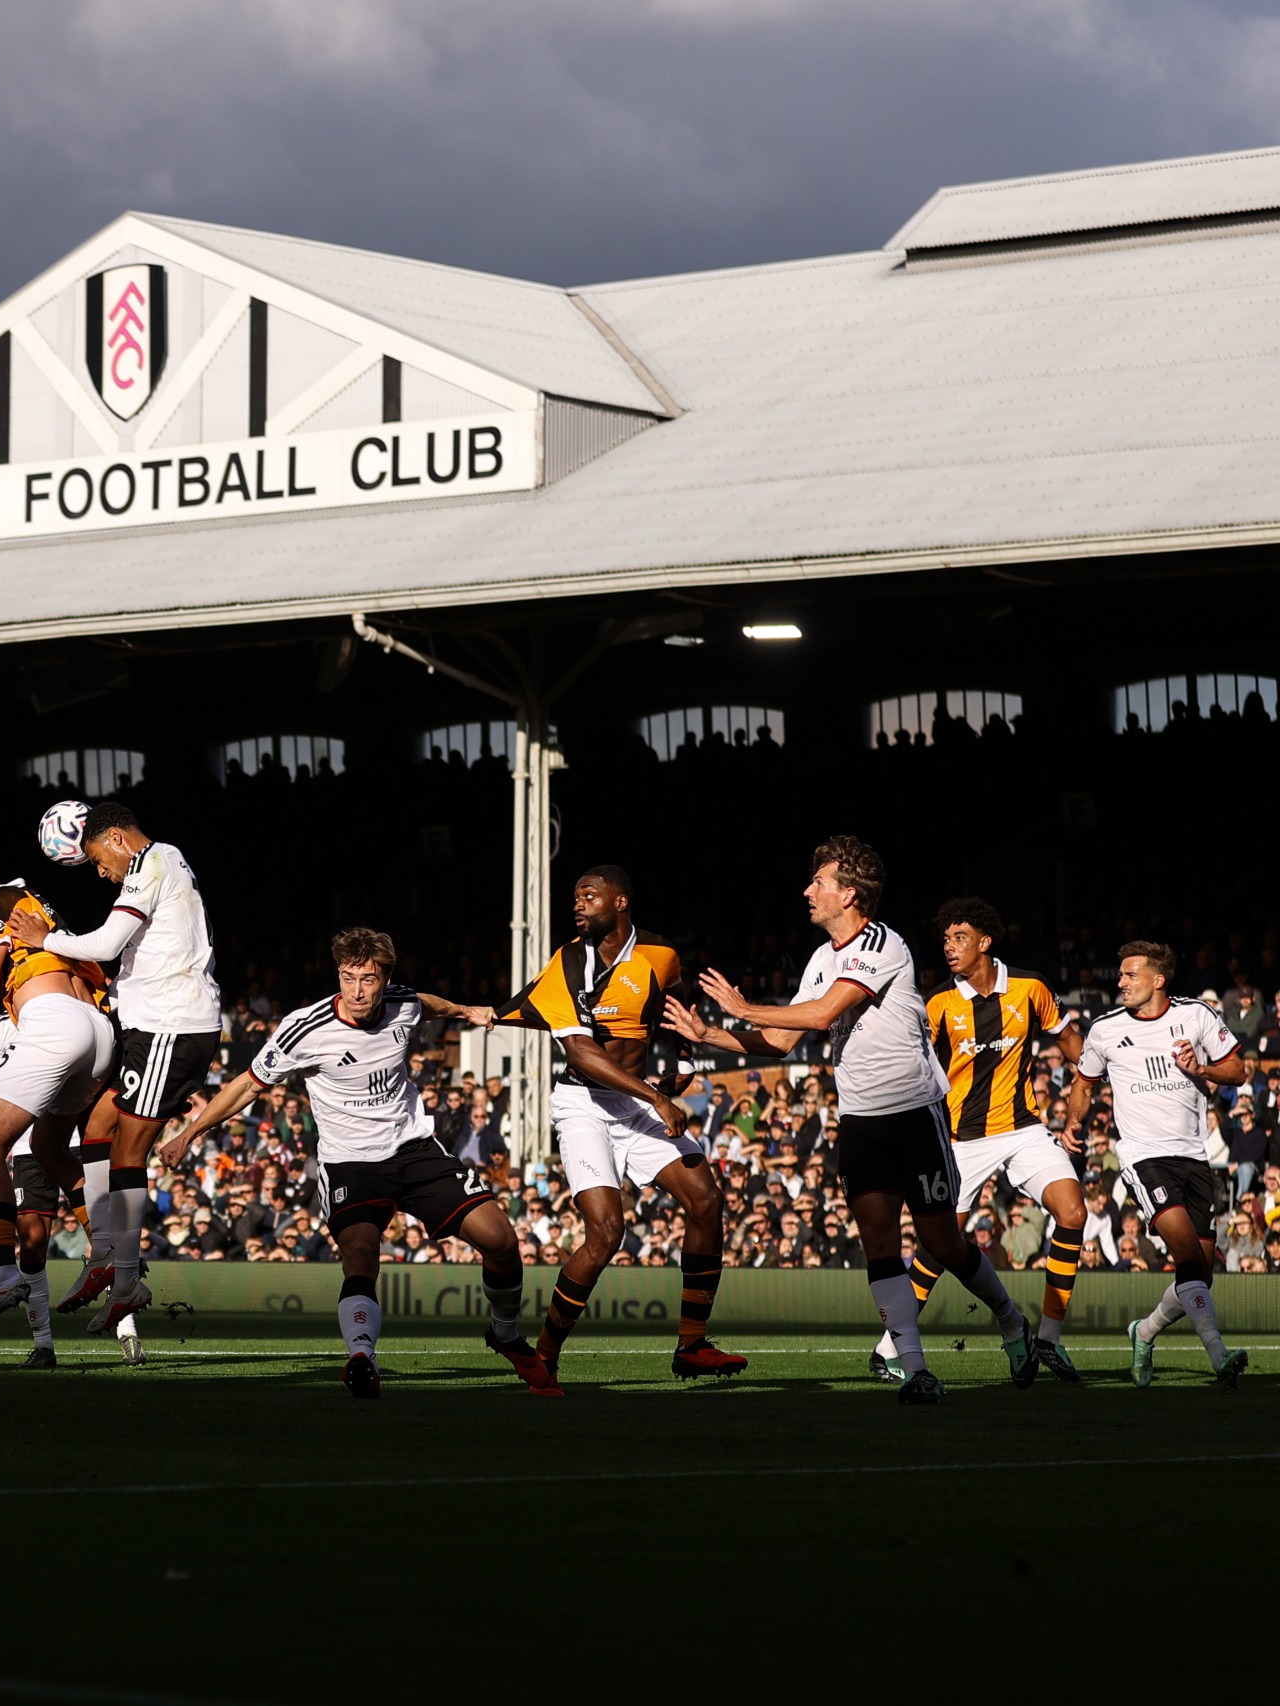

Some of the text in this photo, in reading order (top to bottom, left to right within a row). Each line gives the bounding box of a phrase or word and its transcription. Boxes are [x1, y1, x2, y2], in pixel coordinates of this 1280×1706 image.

[25, 447, 316, 524] FOOTBALL
[351, 426, 503, 490] CLUB
[1131, 1080, 1191, 1093] ClickHouse
[918, 1171, 949, 1204] 16
